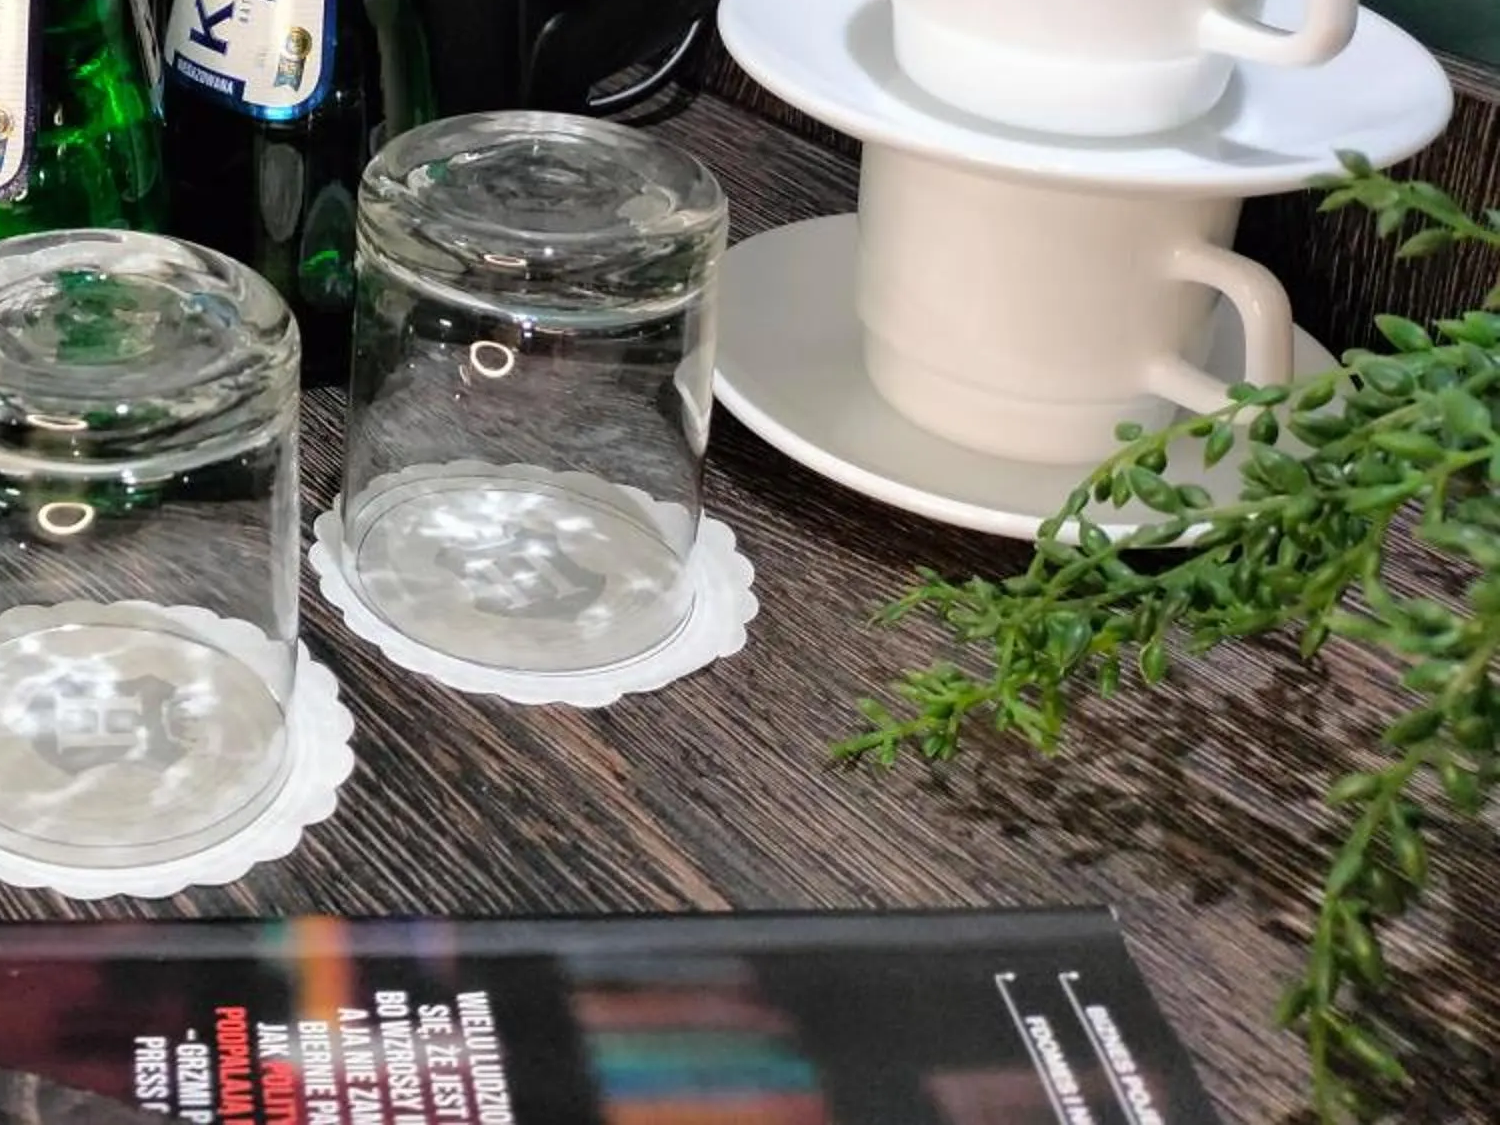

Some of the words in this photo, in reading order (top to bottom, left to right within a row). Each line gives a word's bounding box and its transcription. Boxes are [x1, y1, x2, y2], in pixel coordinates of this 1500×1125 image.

[337, 1007, 369, 1021] A
[375, 990, 410, 1018] BO
[456, 990, 499, 1050] WIELU
[257, 1022, 291, 1058] JAK
[298, 1021, 337, 1096] BIERNIE
[340, 1026, 371, 1047] JA
[134, 1036, 169, 1099] PRESS
[176, 1043, 212, 1106] GRZMI
[344, 1051, 377, 1084] NIE
[380, 1020, 425, 1111] WZROSŁY
[430, 1072, 469, 1119] JEST
